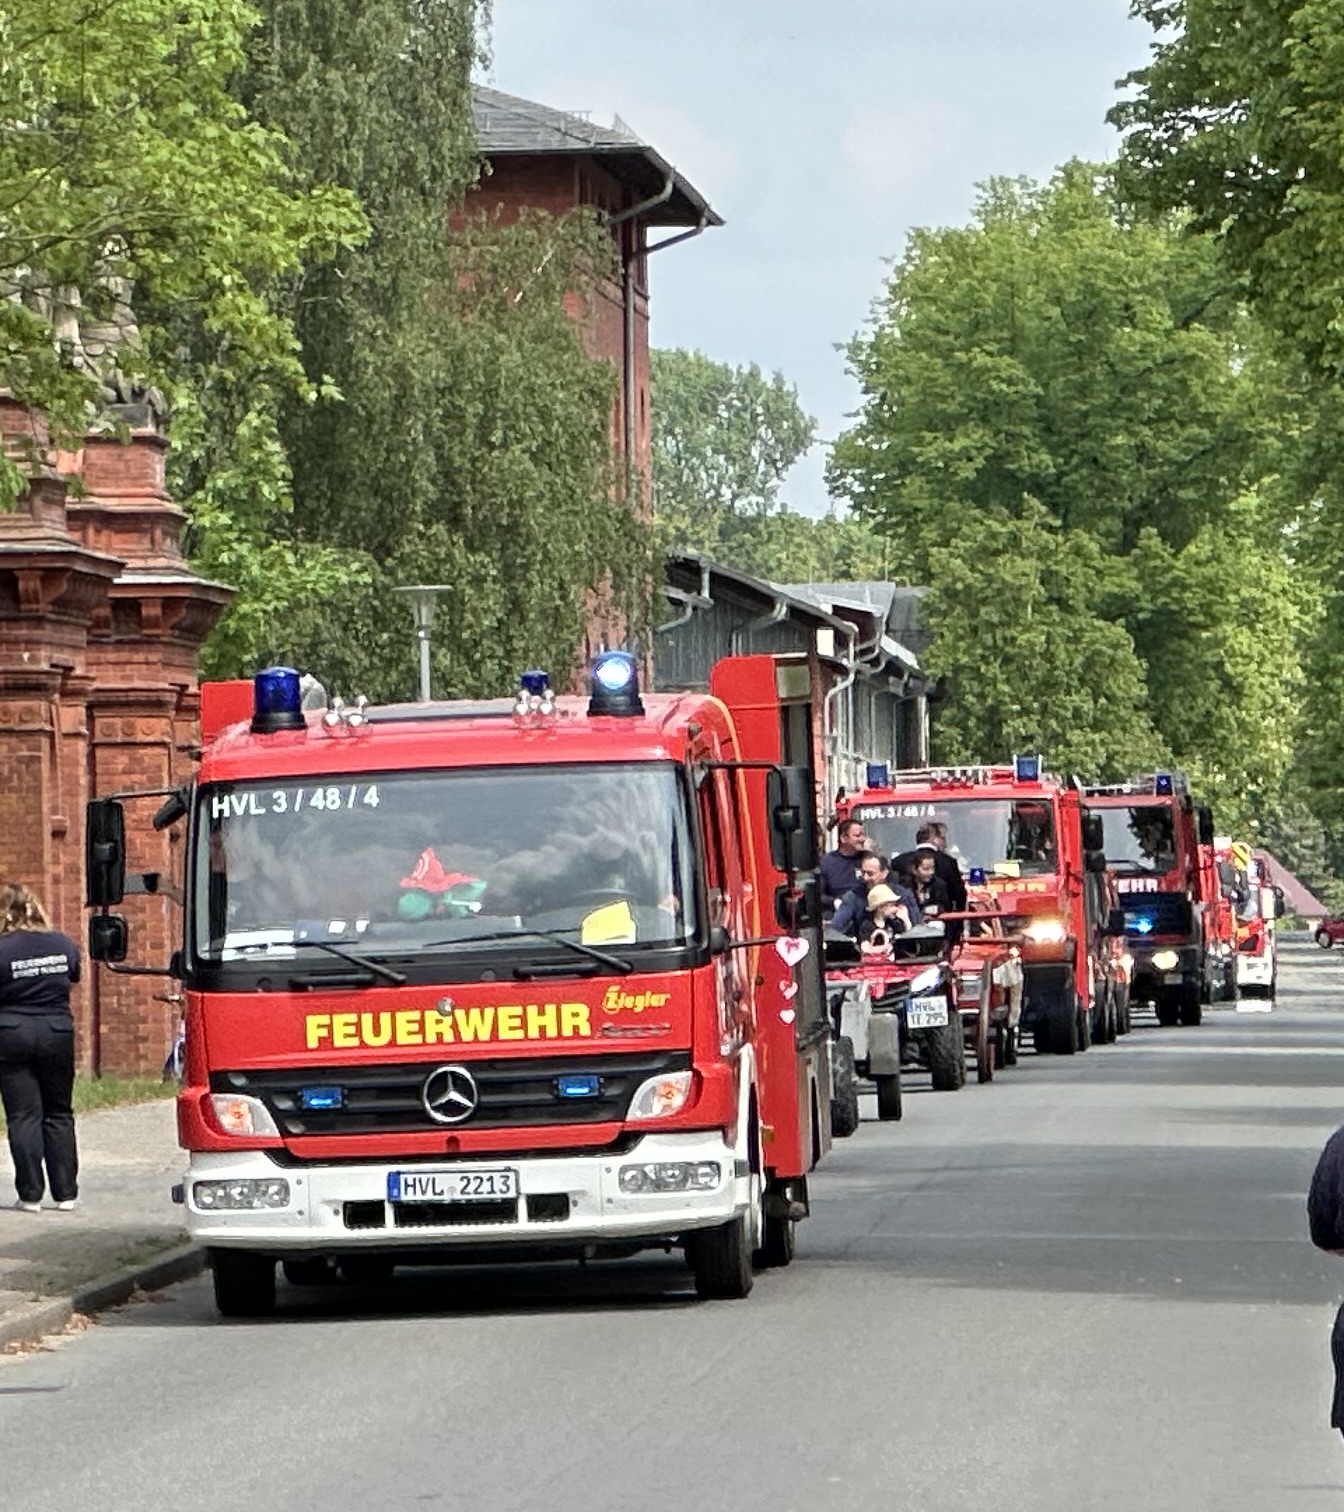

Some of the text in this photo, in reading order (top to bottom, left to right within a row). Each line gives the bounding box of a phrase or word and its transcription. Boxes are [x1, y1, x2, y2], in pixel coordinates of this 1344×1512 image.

[212, 792, 266, 819] HVL
[306, 1003, 591, 1049] FEUERWEHR
[404, 1175, 510, 1196] HVL 2213
